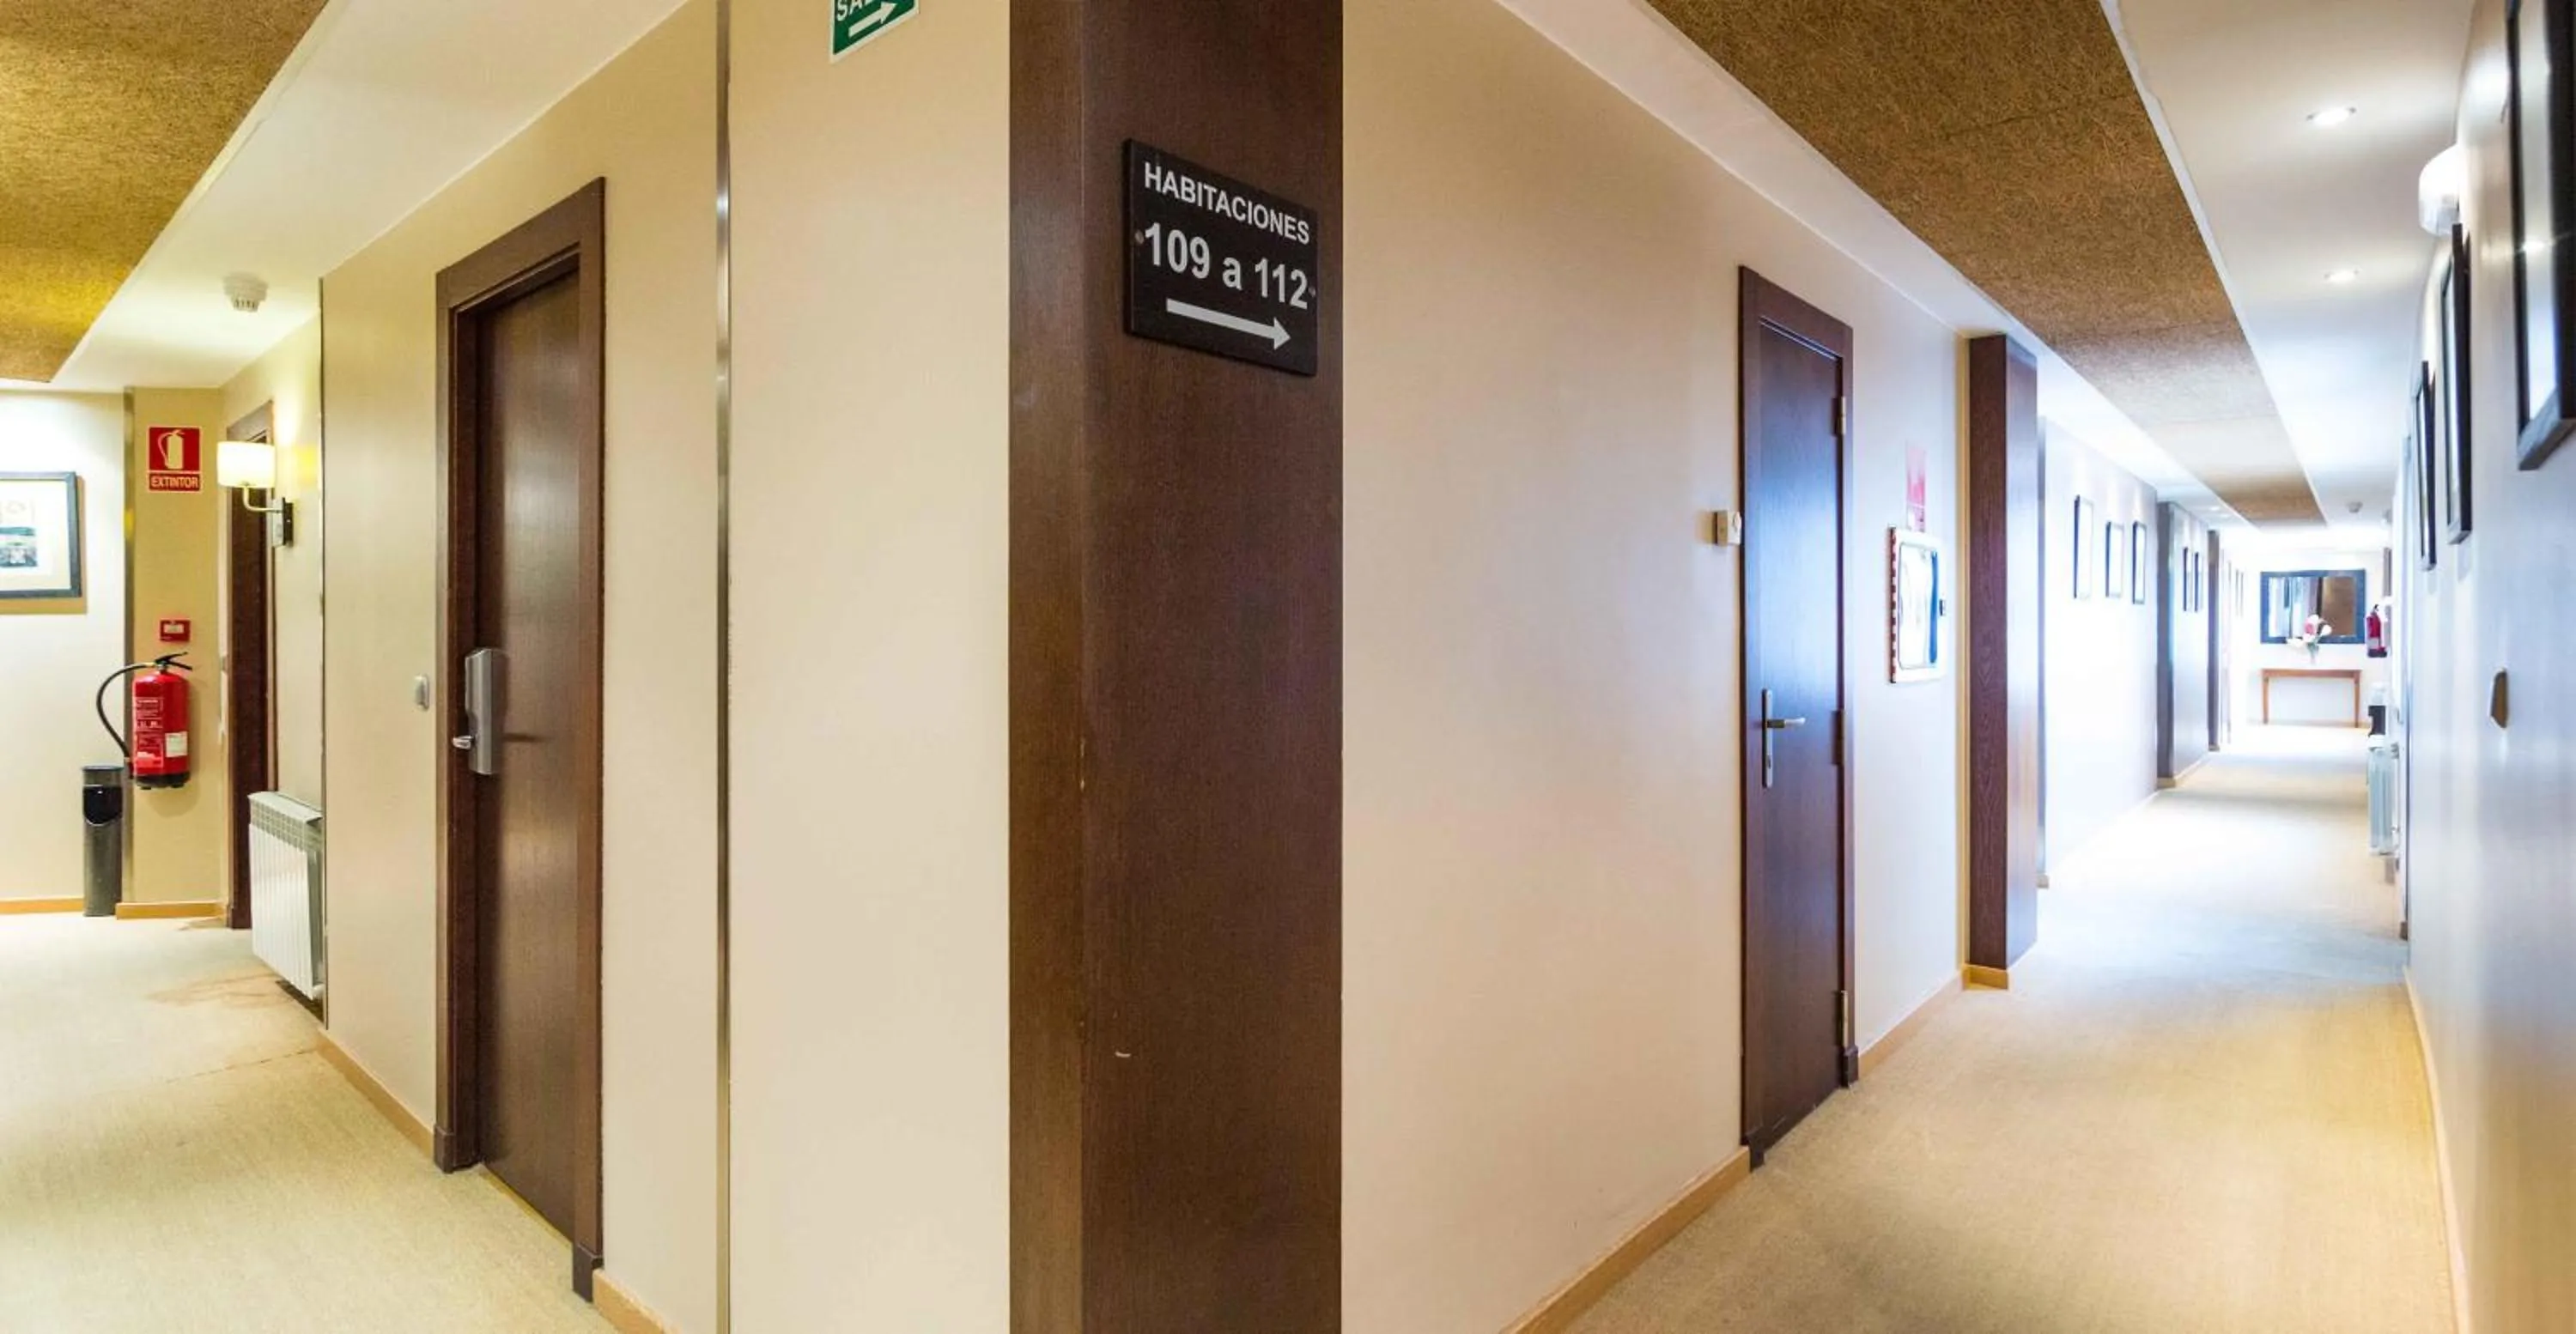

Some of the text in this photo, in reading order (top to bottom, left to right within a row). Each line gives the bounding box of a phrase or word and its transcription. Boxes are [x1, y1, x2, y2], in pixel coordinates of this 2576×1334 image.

[1144, 161, 1309, 245] HABITACIONES
[1145, 221, 1309, 310] 109 a 112
[150, 476, 198, 488] EXTINTOR
